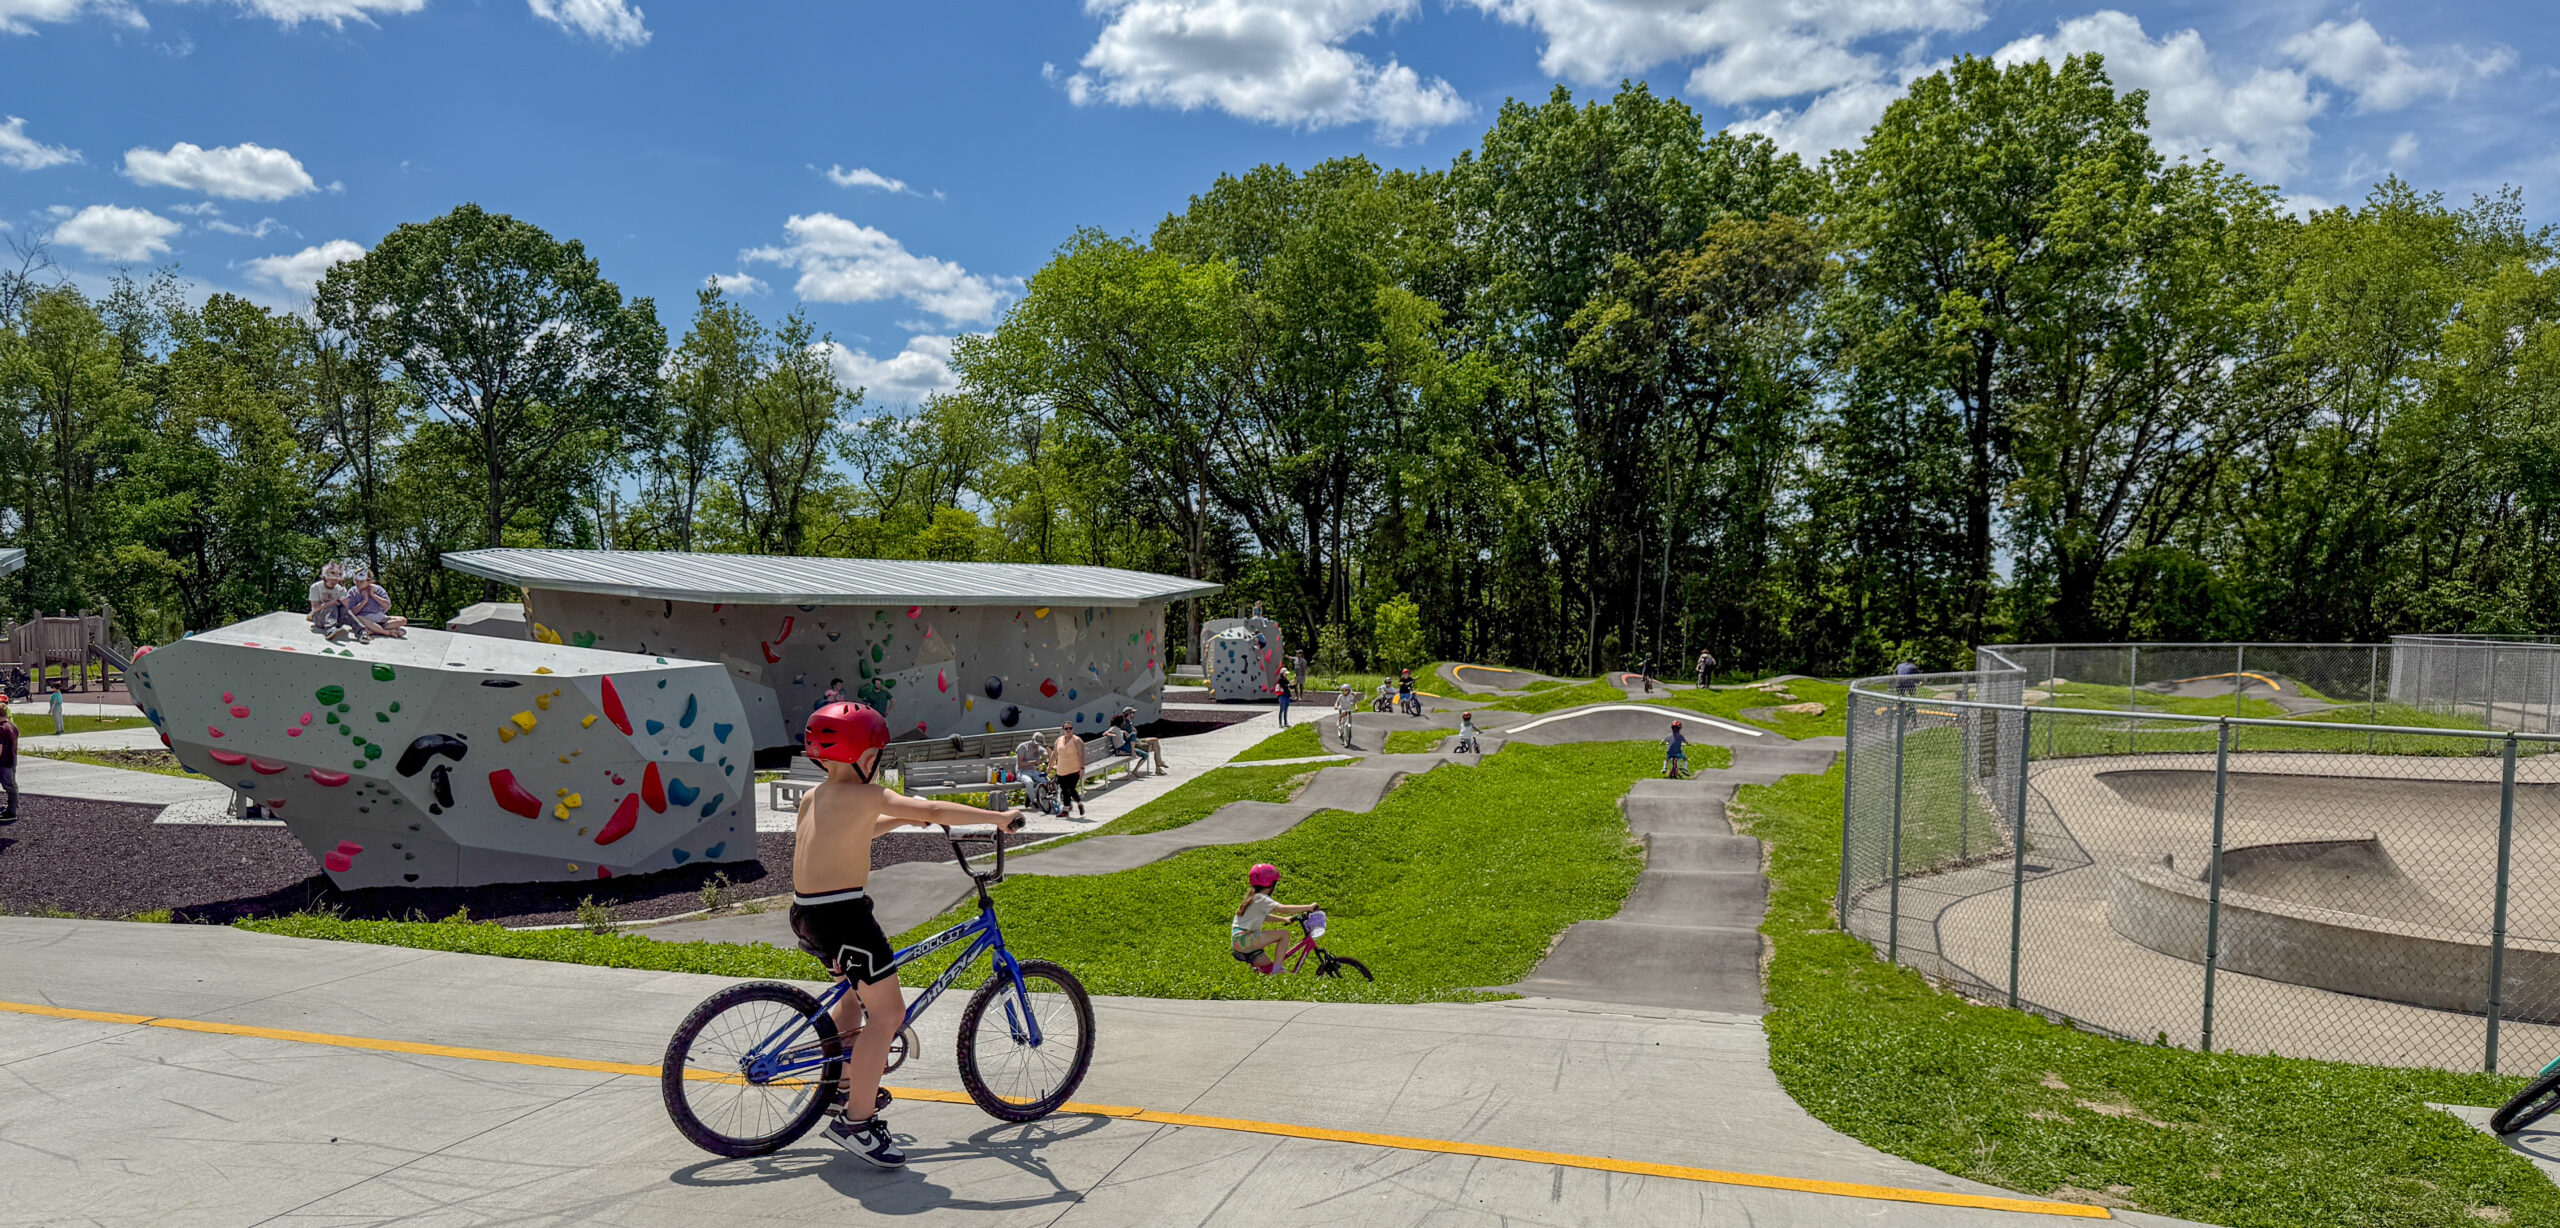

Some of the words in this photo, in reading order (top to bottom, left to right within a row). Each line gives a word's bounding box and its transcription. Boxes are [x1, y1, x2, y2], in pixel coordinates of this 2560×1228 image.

[913, 938, 944, 957] ROCK
[947, 928, 961, 941] IT
[927, 955, 968, 1002] HUFFY
